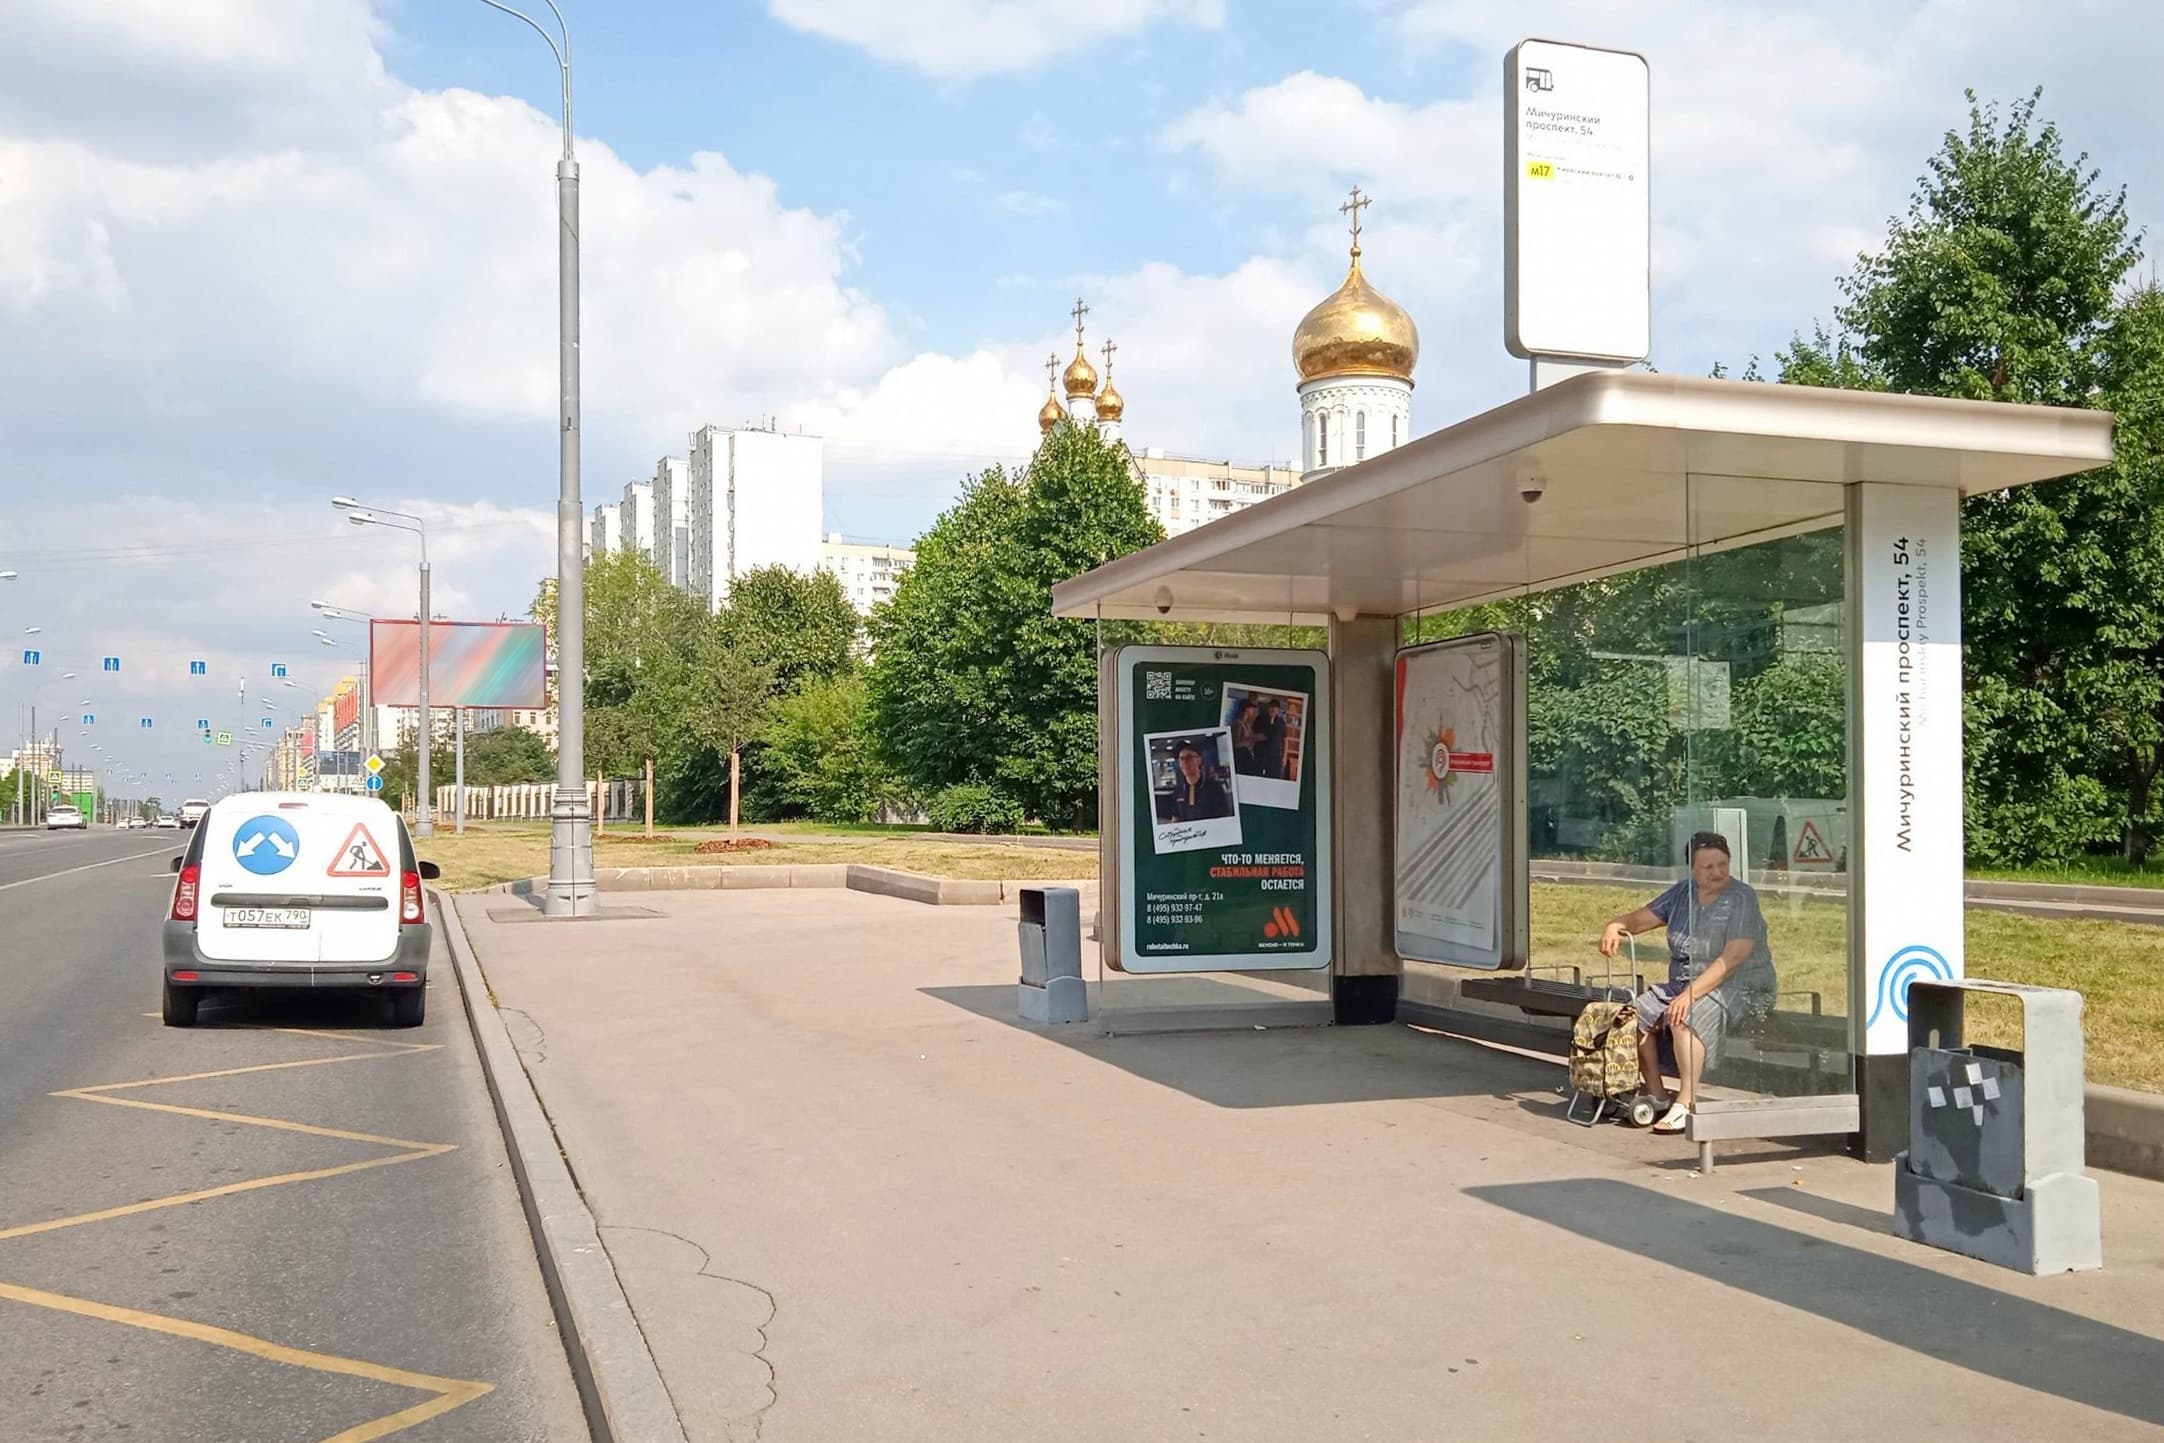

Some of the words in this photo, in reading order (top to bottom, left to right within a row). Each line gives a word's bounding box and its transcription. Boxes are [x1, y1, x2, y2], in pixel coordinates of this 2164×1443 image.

[1526, 107, 1601, 124] Мичуринский
[1526, 120, 1578, 135] проспект,
[1580, 125, 1593, 136] 54
[1893, 536, 1909, 565] 54
[1915, 537, 1926, 557] 54
[1915, 562, 1929, 629] Prospekt,
[1897, 573, 1913, 683] проспект,
[1896, 692, 1915, 852] Мичуринский
[1221, 853, 1252, 865] ЧТО-ТО
[1254, 853, 1304, 866] МЕНЯЕТСЯ,
[1209, 866, 1269, 878] СТАБИЛЬНАЯ
[1271, 866, 1304, 878] РАБОТА
[1261, 879, 1304, 890] ОСТАЕТСЯ
[1146, 904, 1152, 913] 8
[1152, 903, 1170, 914] (495)
[1170, 903, 1203, 912] 932-97-47
[1146, 915, 1152, 924] 8
[1152, 915, 1170, 925] (495)
